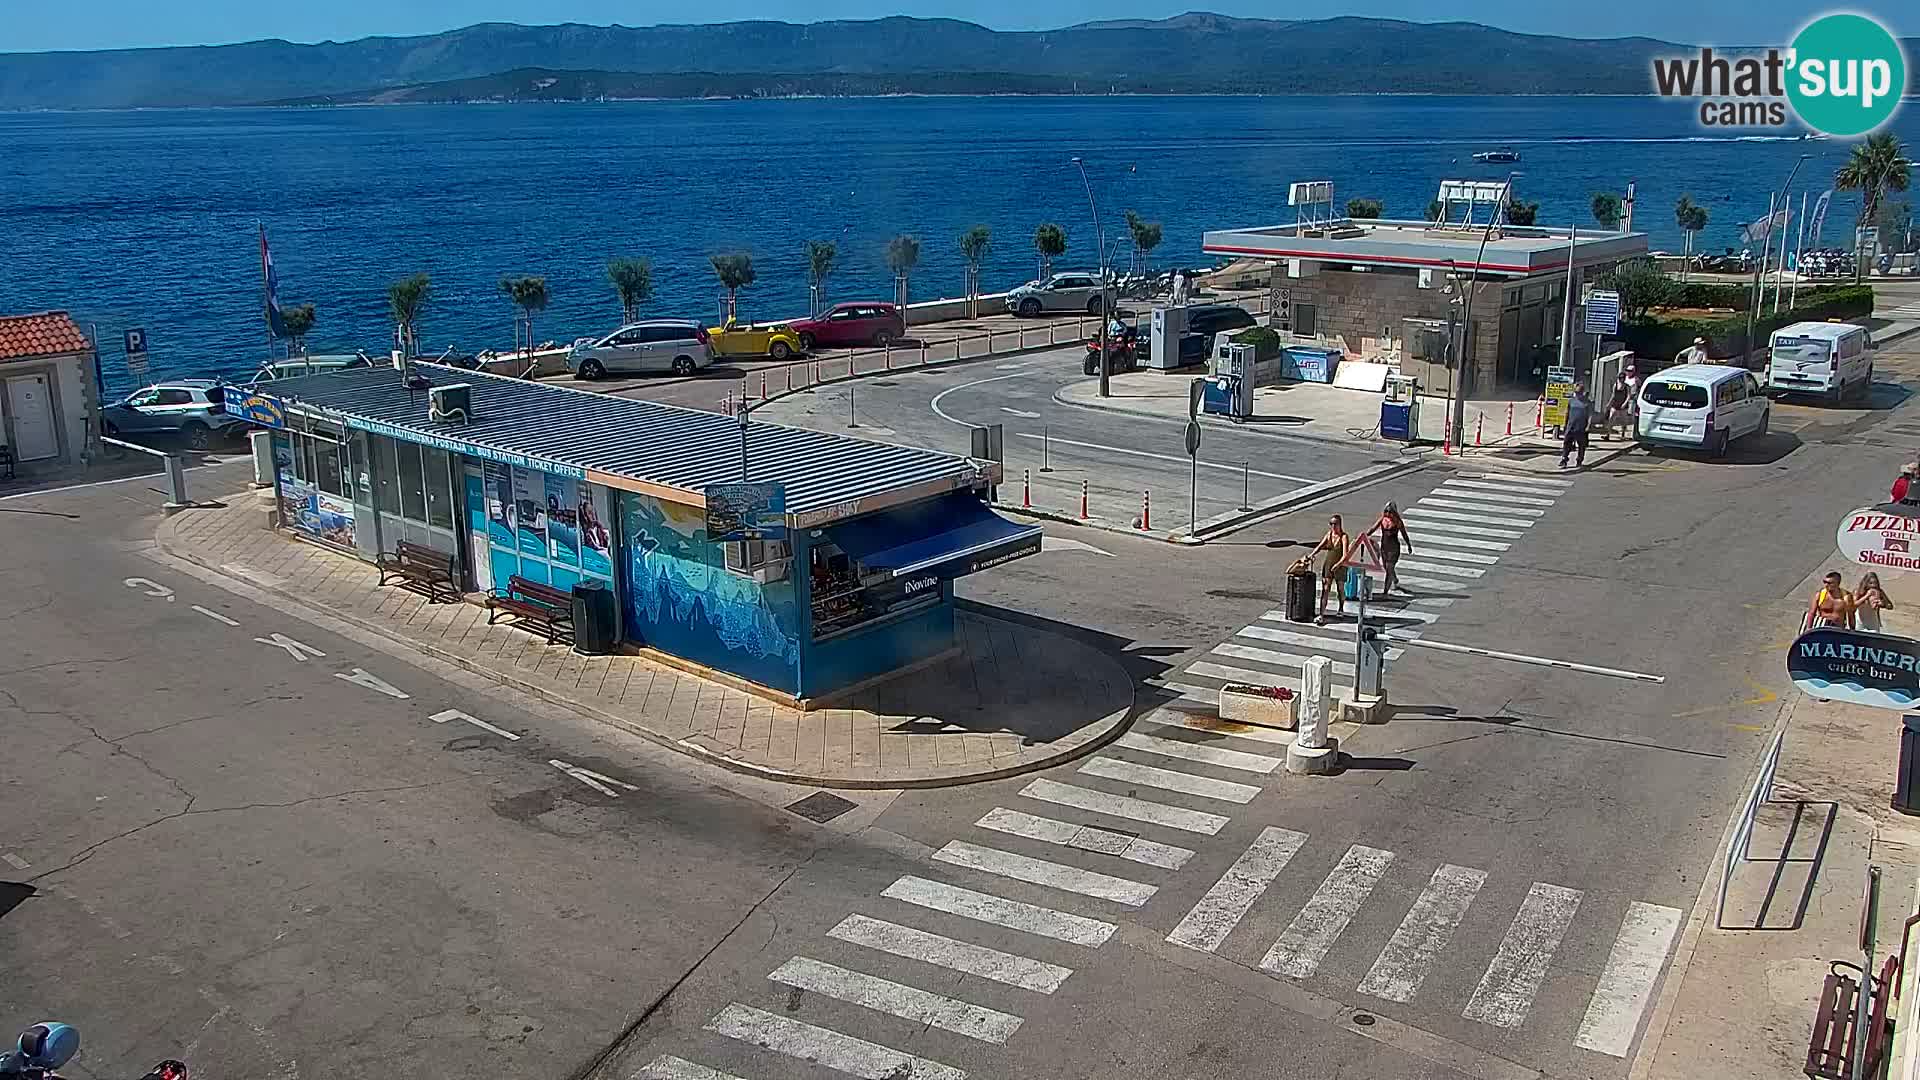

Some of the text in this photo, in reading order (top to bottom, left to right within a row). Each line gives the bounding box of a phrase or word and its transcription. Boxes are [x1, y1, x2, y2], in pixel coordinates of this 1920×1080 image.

[128, 332, 141, 350] P
[1667, 383, 1687, 391] TAXI
[394, 427, 435, 445] AUTOBUSNA
[435, 438, 467, 453] POSTAJA
[477, 447, 492, 459] BUS
[492, 450, 526, 466] STATION
[527, 458, 553, 472] TICKET
[553, 463, 582, 478] OFFICE
[1881, 530, 1916, 541] GRILL
[904, 576, 938, 594] iNovine
[1828, 662, 1896, 680] caffe bar
